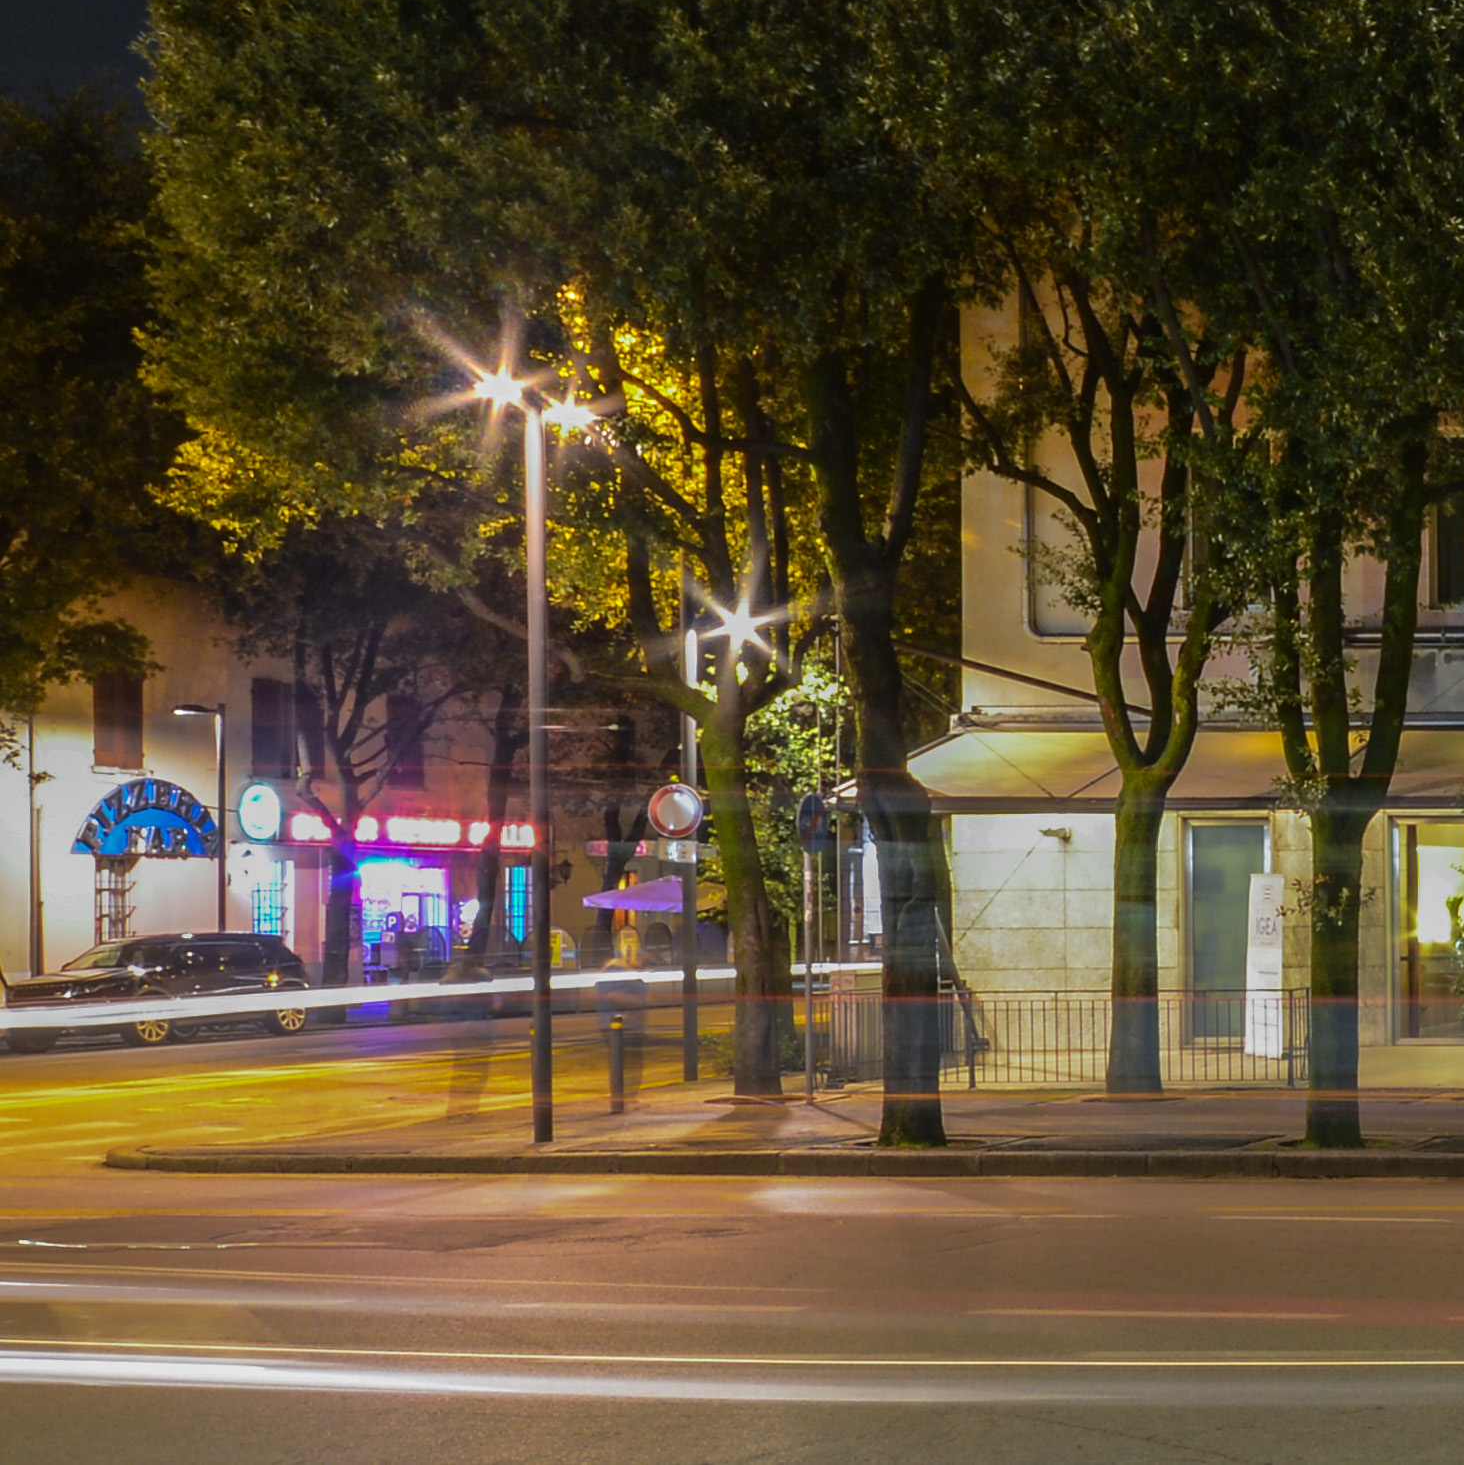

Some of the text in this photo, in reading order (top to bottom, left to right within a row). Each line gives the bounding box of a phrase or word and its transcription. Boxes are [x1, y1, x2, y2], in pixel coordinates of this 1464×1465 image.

[76, 778, 220, 855] PIZZERIA
[124, 826, 188, 854] BAR
[1255, 916, 1279, 936] IGEA
